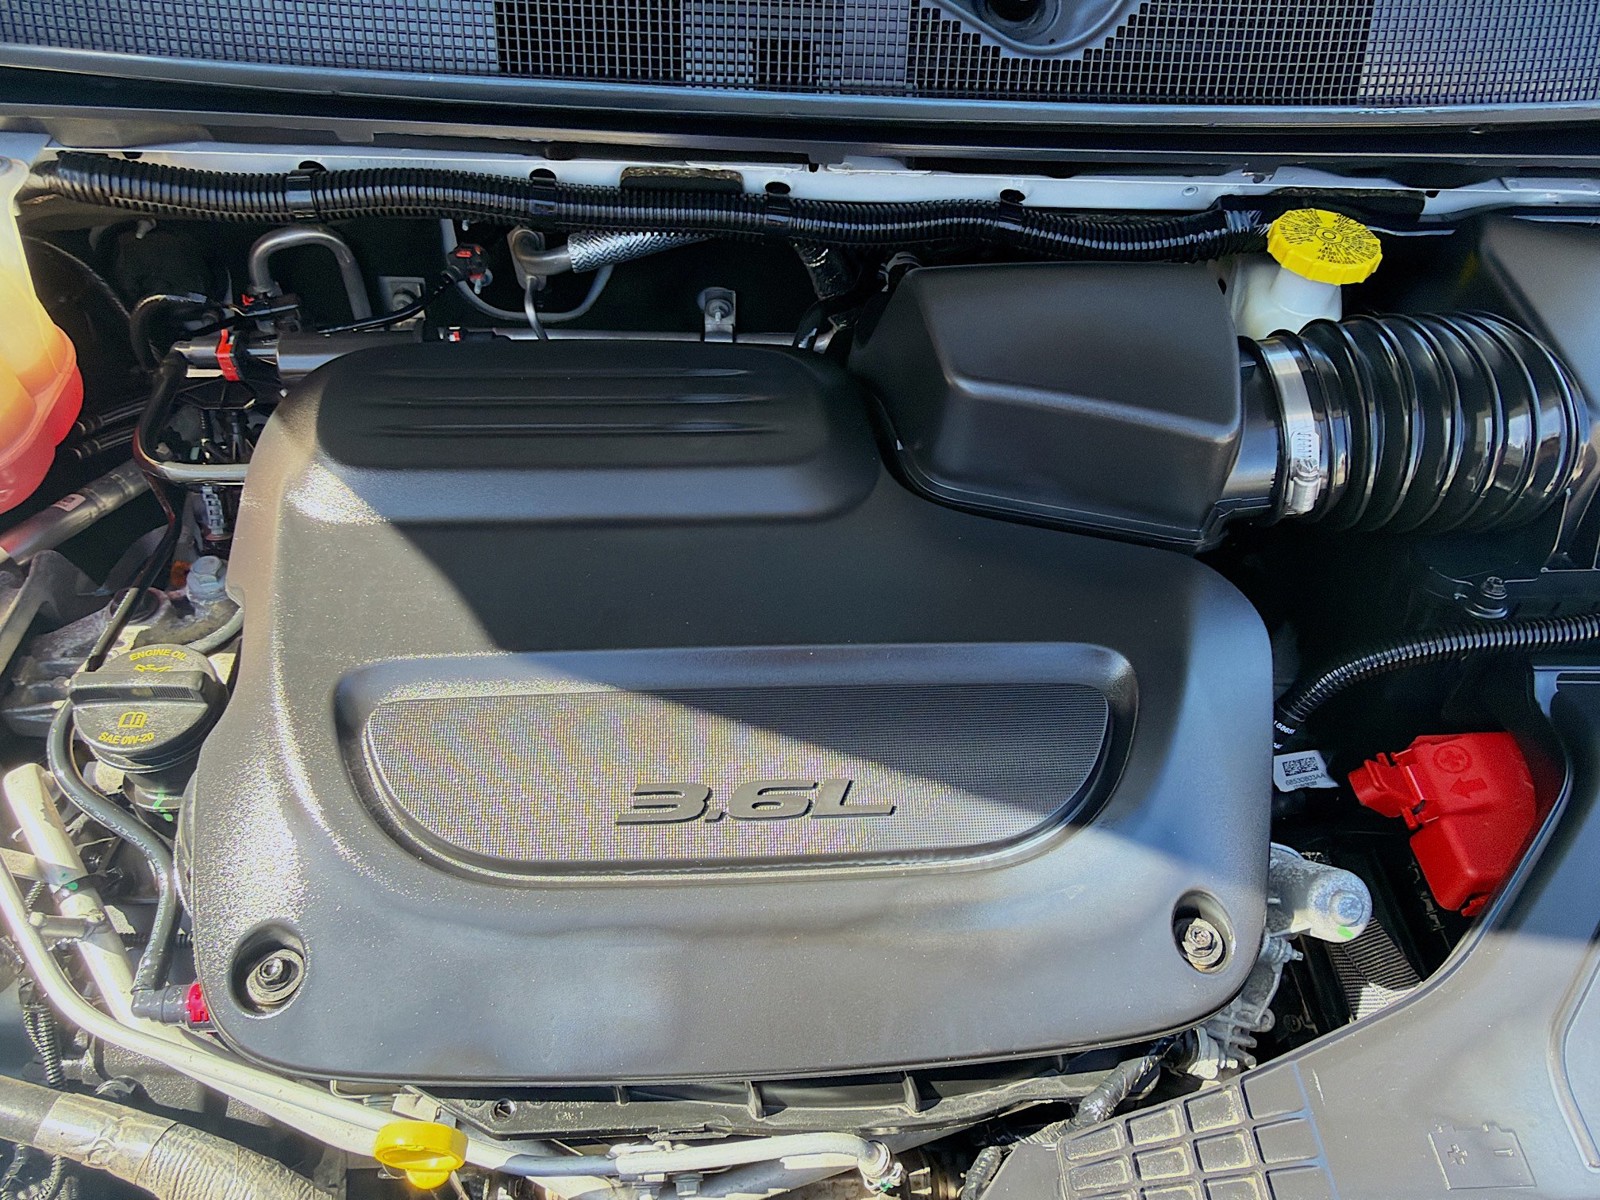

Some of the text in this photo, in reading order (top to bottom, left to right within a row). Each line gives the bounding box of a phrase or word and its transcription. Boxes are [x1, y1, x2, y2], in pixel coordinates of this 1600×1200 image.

[129, 648, 187, 661] ENGINE OIL
[98, 732, 154, 745] SAE 0W-20
[615, 779, 896, 825] 3.6L
